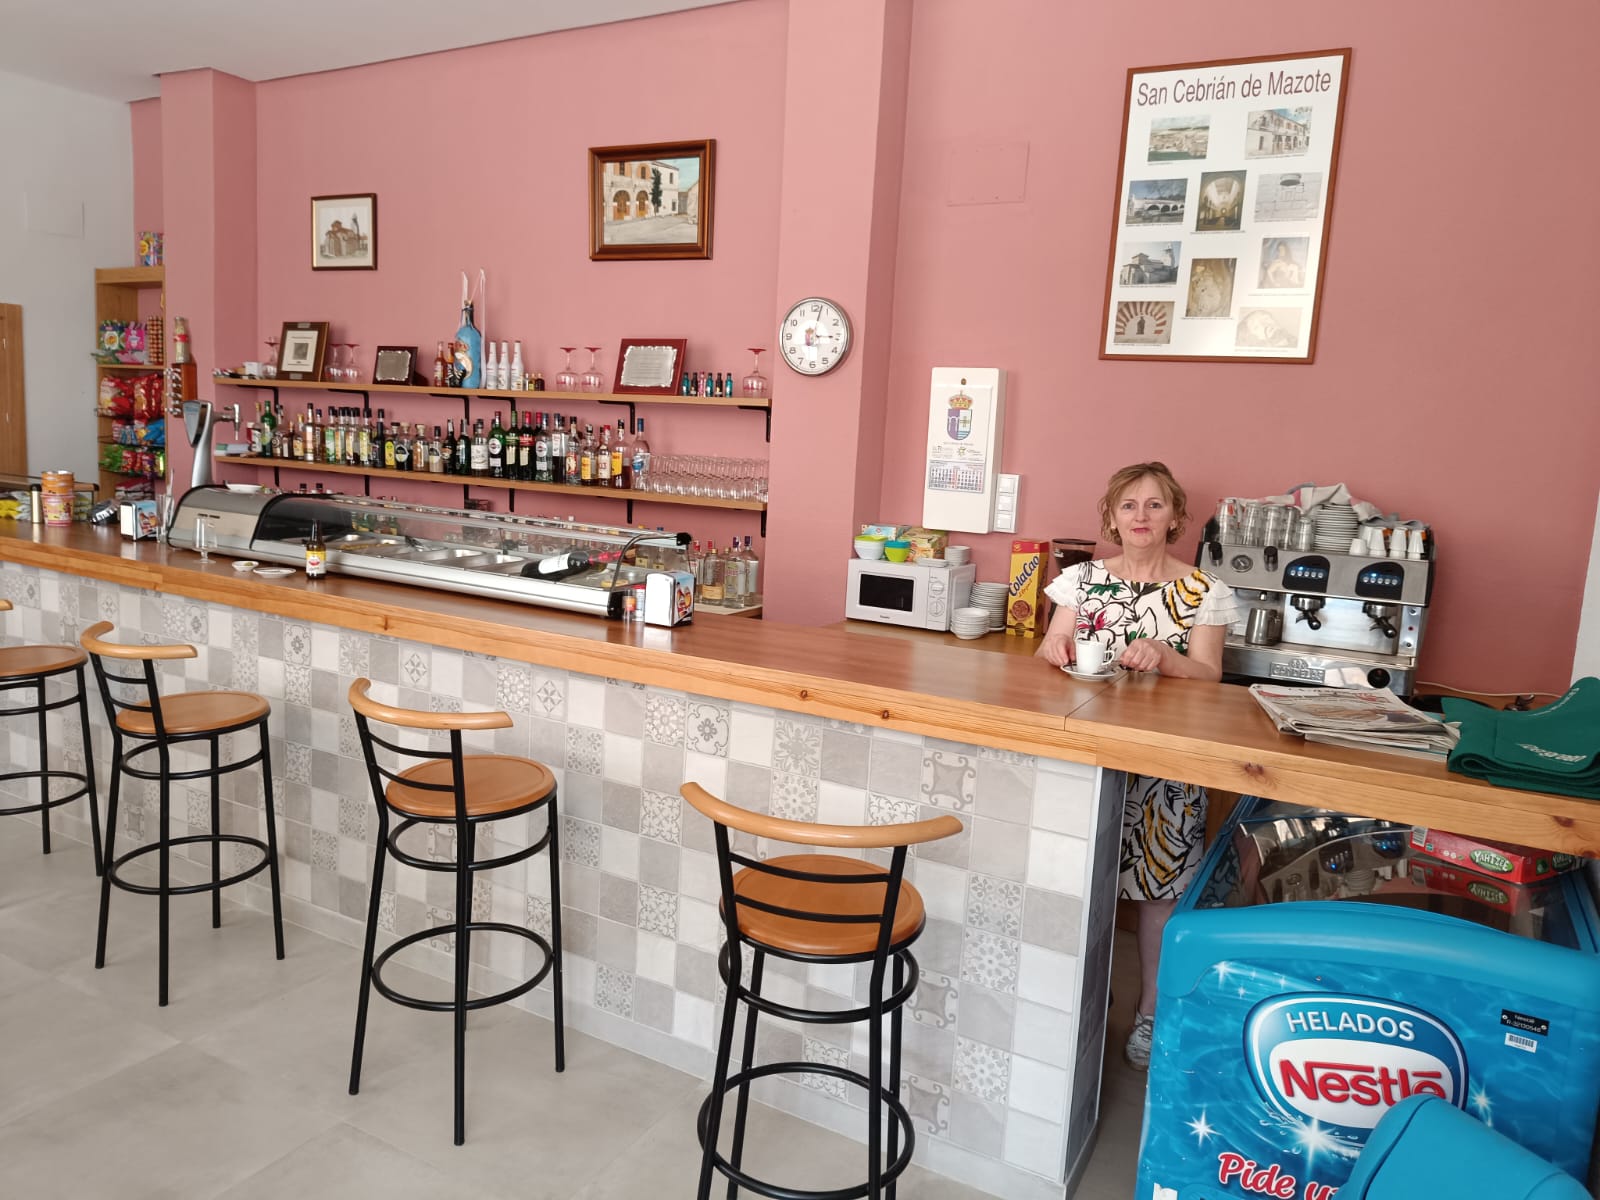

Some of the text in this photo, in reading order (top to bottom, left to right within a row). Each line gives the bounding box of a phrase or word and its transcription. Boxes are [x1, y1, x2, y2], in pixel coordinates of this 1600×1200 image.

[1137, 69, 1332, 107] San Cebrián de Mazote
[1008, 555, 1041, 597] ColaCao
[1473, 850, 1510, 872] YAHTZEE
[1286, 1011, 1416, 1042] HELADOS
[1279, 1059, 1447, 1107] Nestlé
[1218, 1151, 1339, 1200] Pide u
